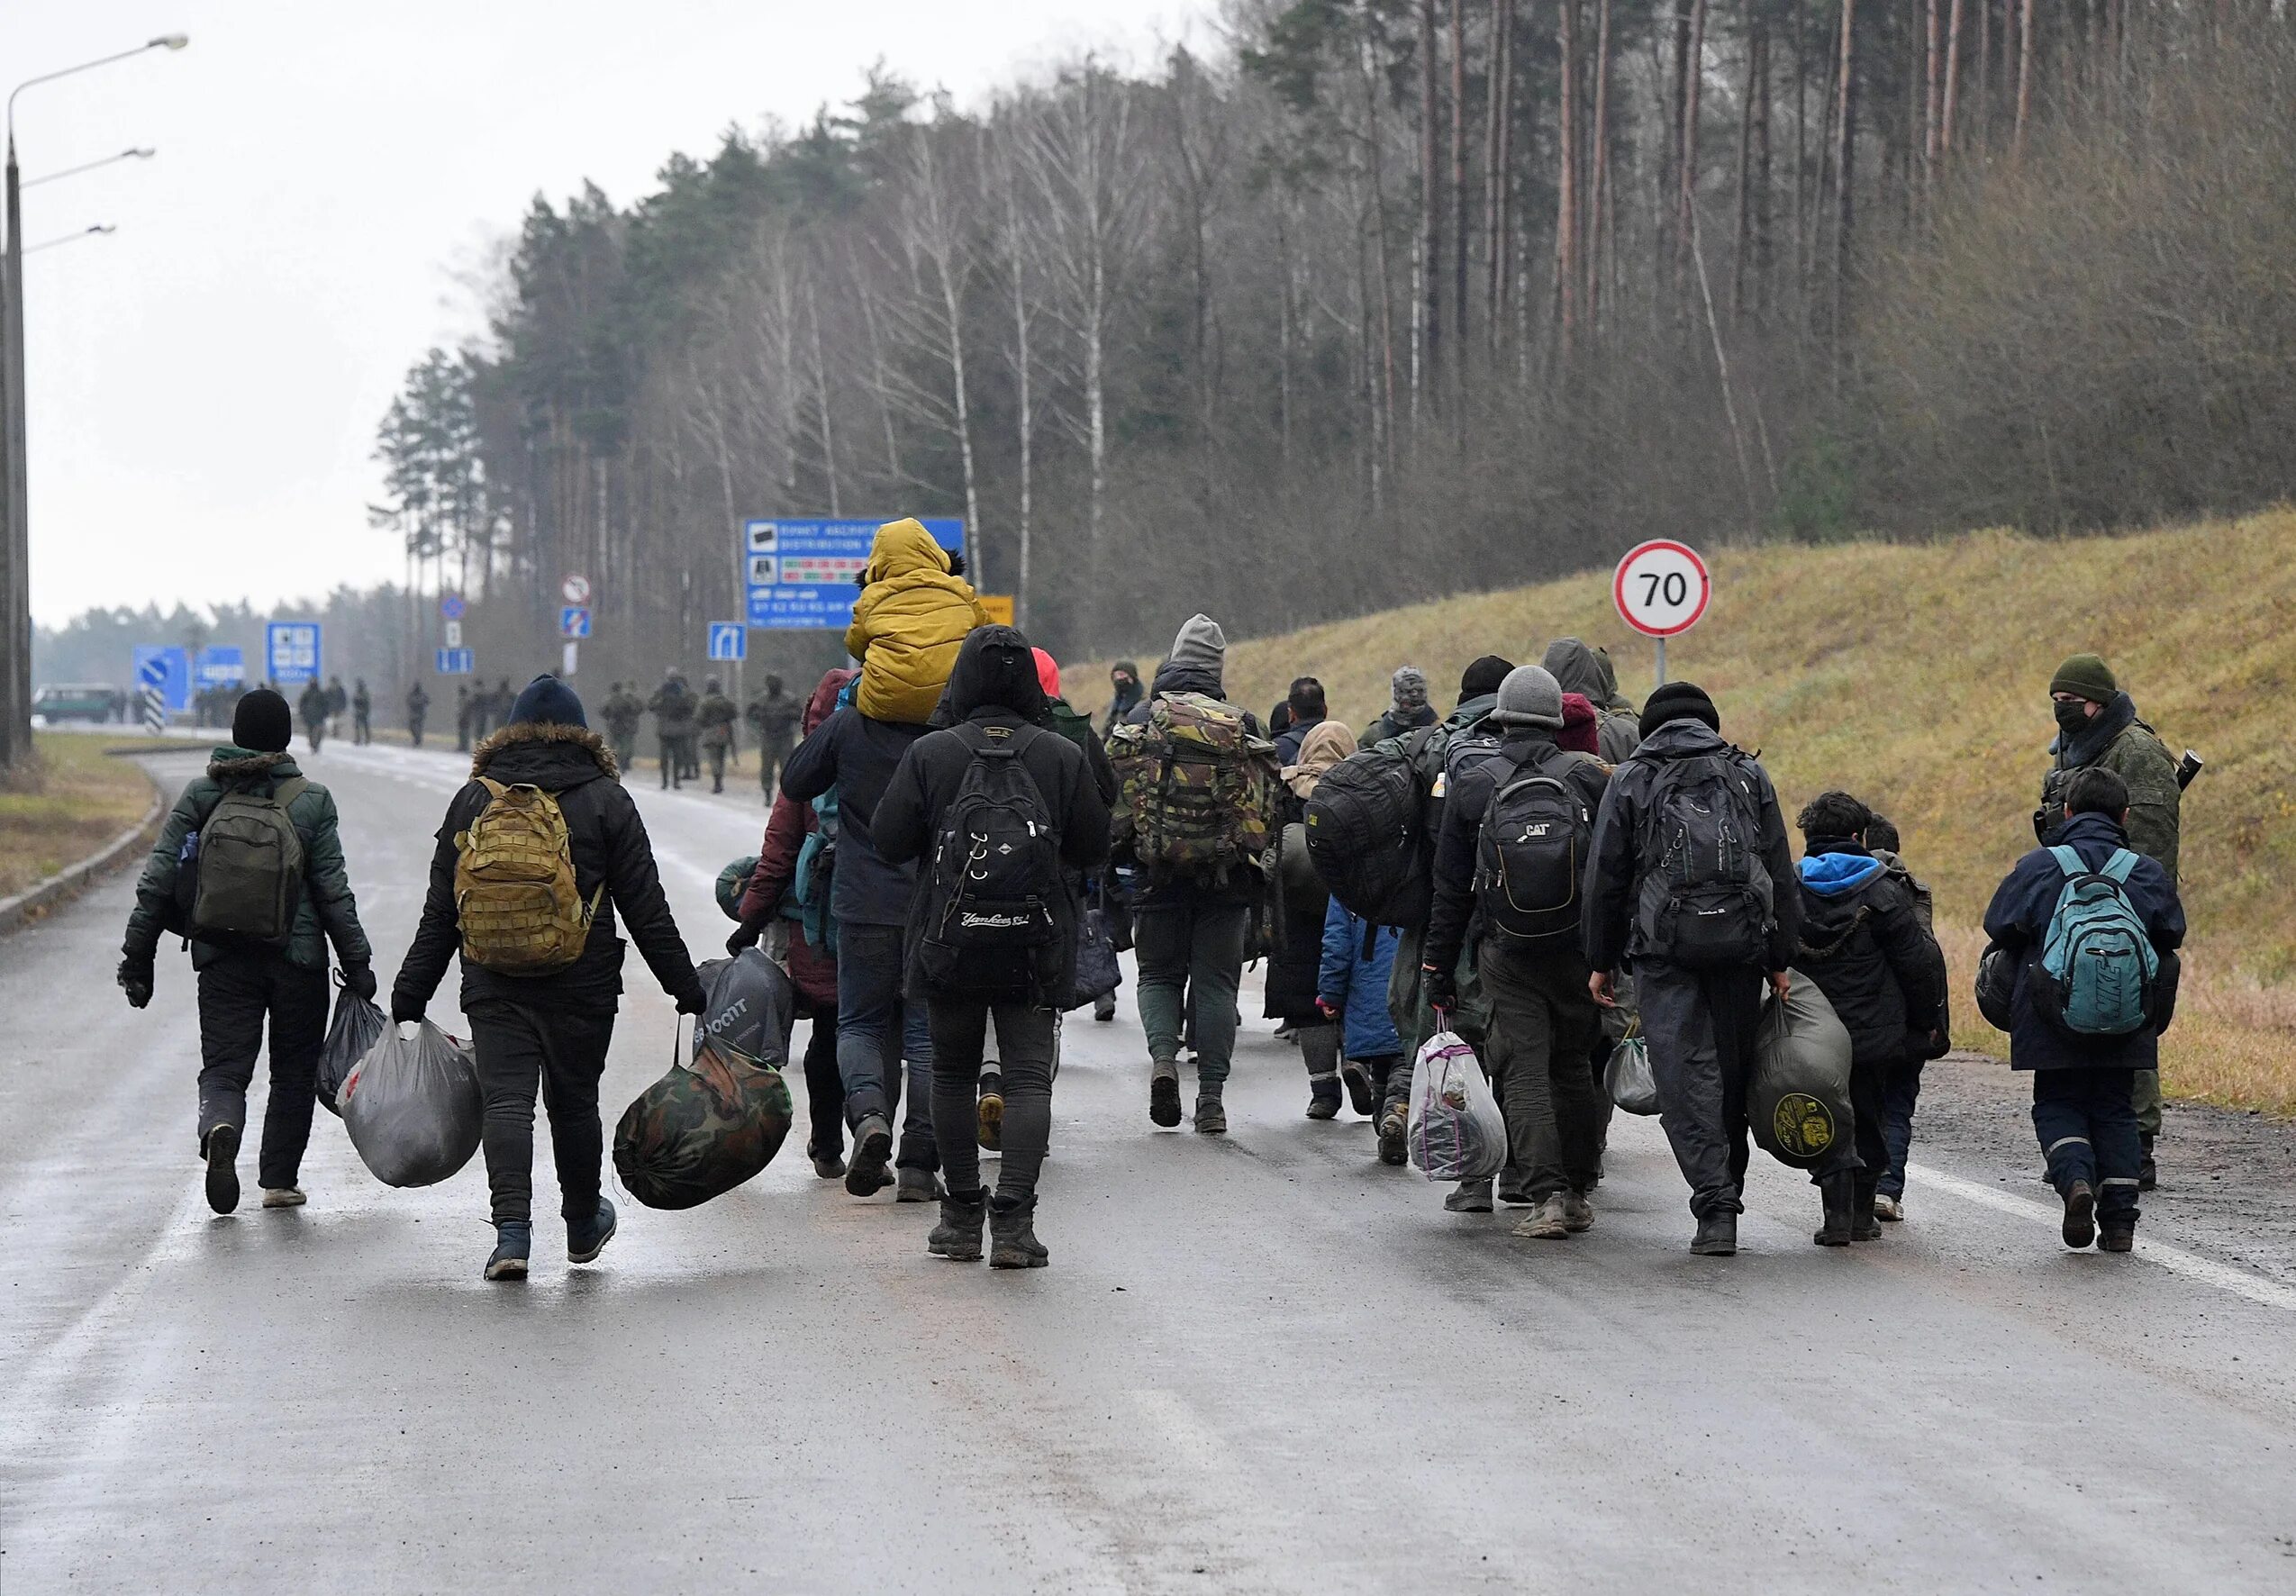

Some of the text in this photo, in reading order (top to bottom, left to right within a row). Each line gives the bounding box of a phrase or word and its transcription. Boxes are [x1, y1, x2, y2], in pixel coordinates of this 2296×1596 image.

[1638, 572, 1686, 607] 70
[1526, 823, 1547, 836] CAT
[2095, 958, 2121, 1019] NIKE
